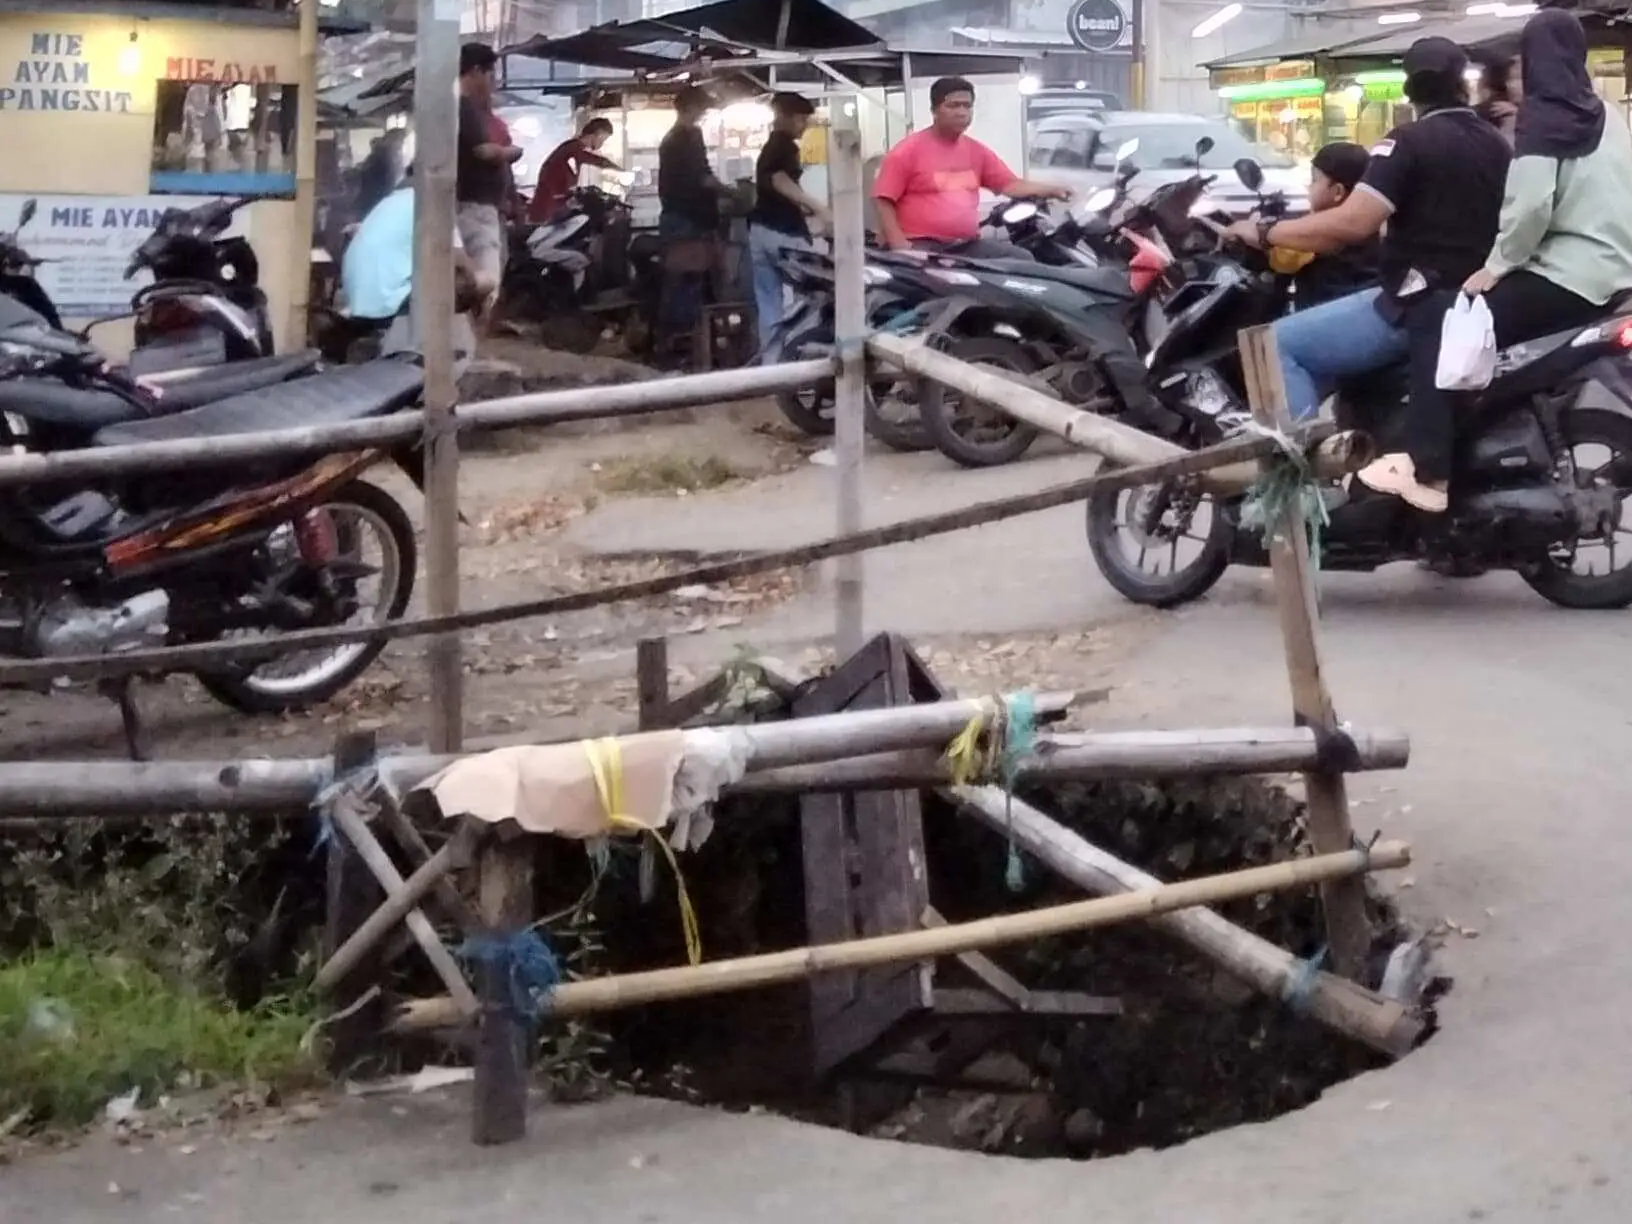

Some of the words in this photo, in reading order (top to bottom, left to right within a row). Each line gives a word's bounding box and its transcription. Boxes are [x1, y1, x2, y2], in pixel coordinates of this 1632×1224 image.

[31, 33, 83, 56] MIE
[0, 88, 132, 113] PANGSIT
[51, 207, 93, 226] MIE
